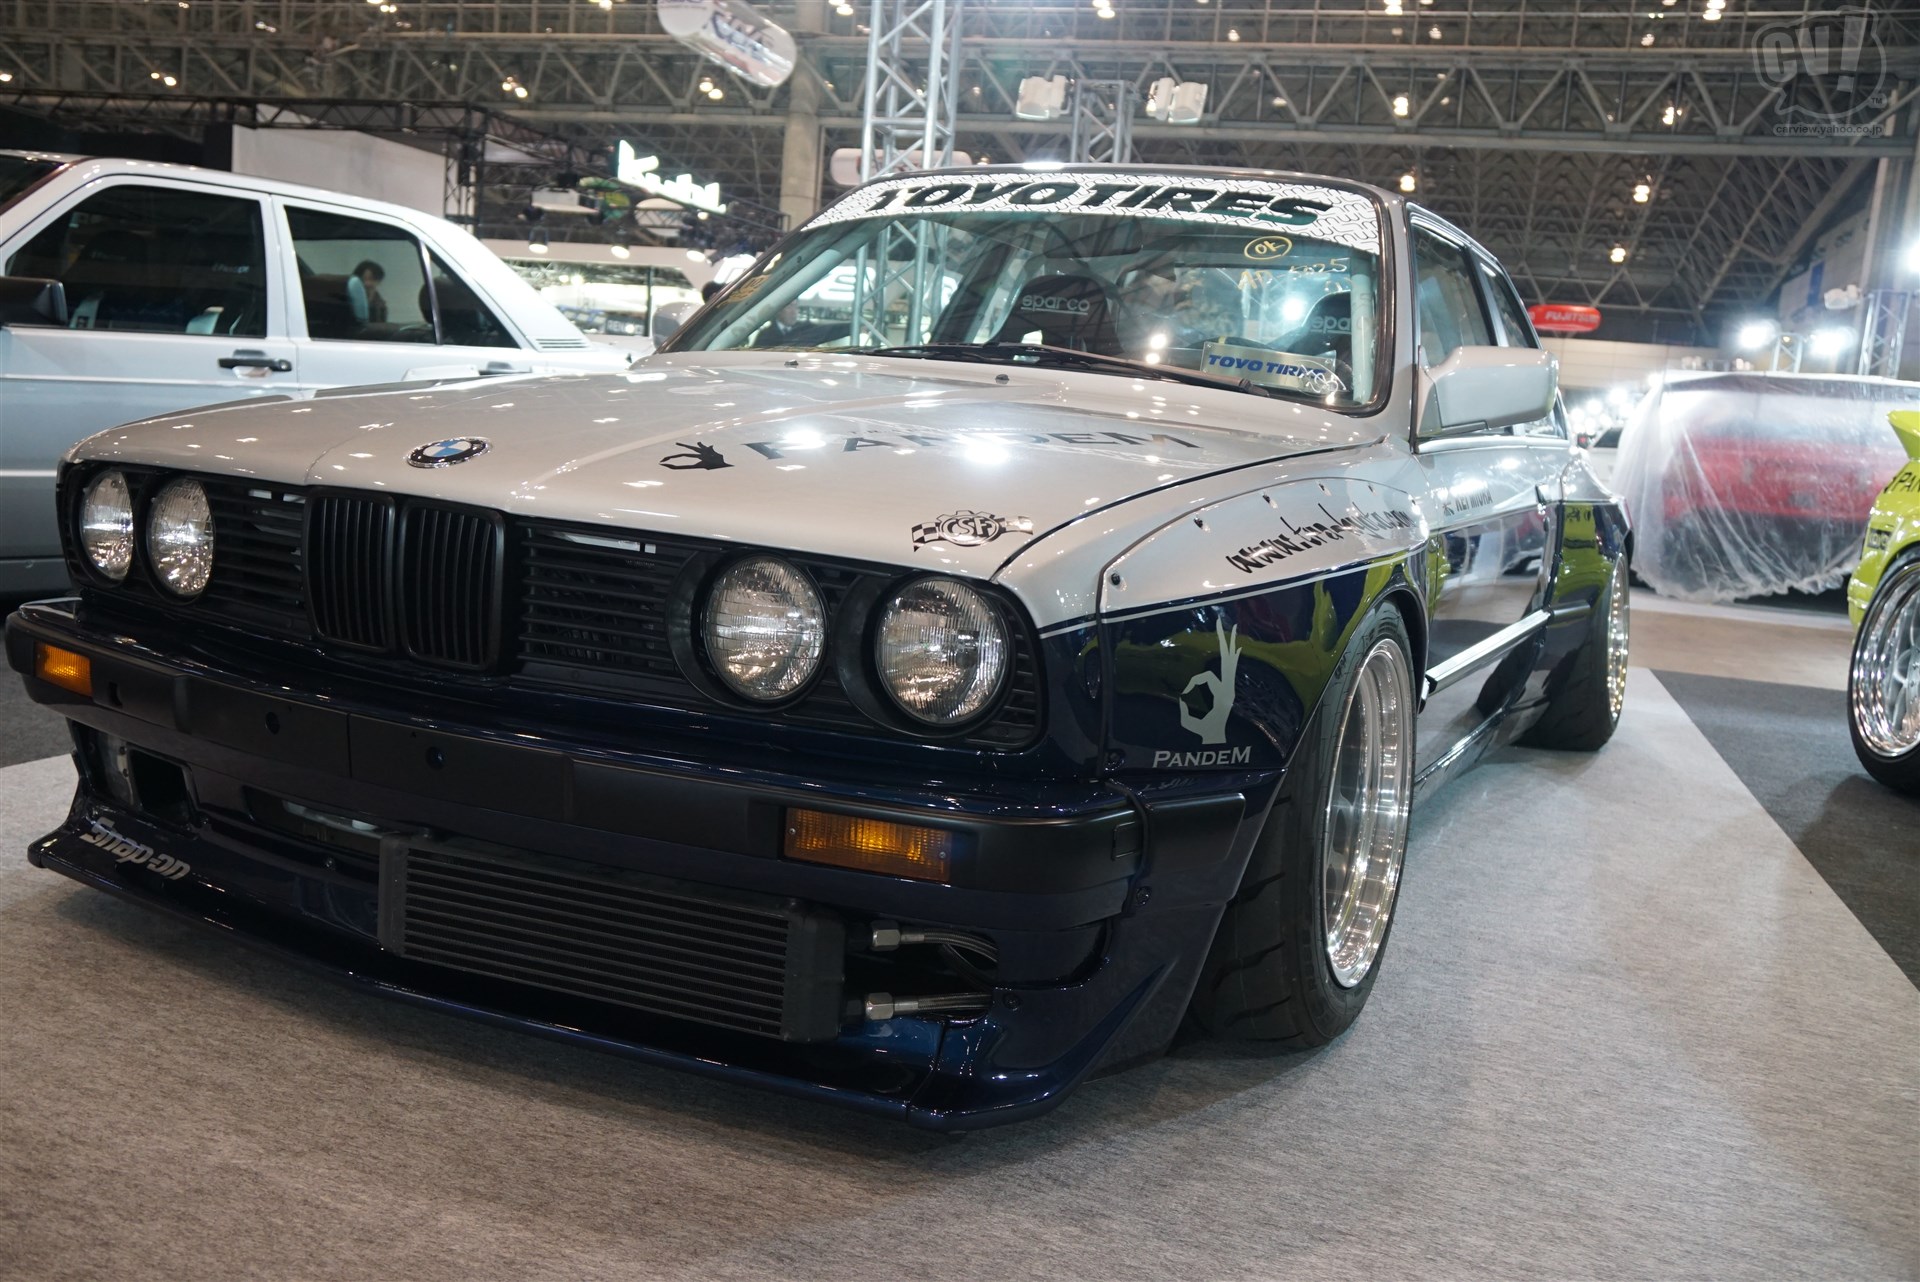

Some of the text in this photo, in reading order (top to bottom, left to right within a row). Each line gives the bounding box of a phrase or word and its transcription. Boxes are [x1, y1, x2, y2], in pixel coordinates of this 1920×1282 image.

[867, 181, 1333, 226] TOYO TIRES
[1021, 294, 1090, 313] sparco
[1208, 354, 1263, 373] TOYO
[742, 430, 1200, 460] PAEM
[79, 816, 191, 880] Snap-on
